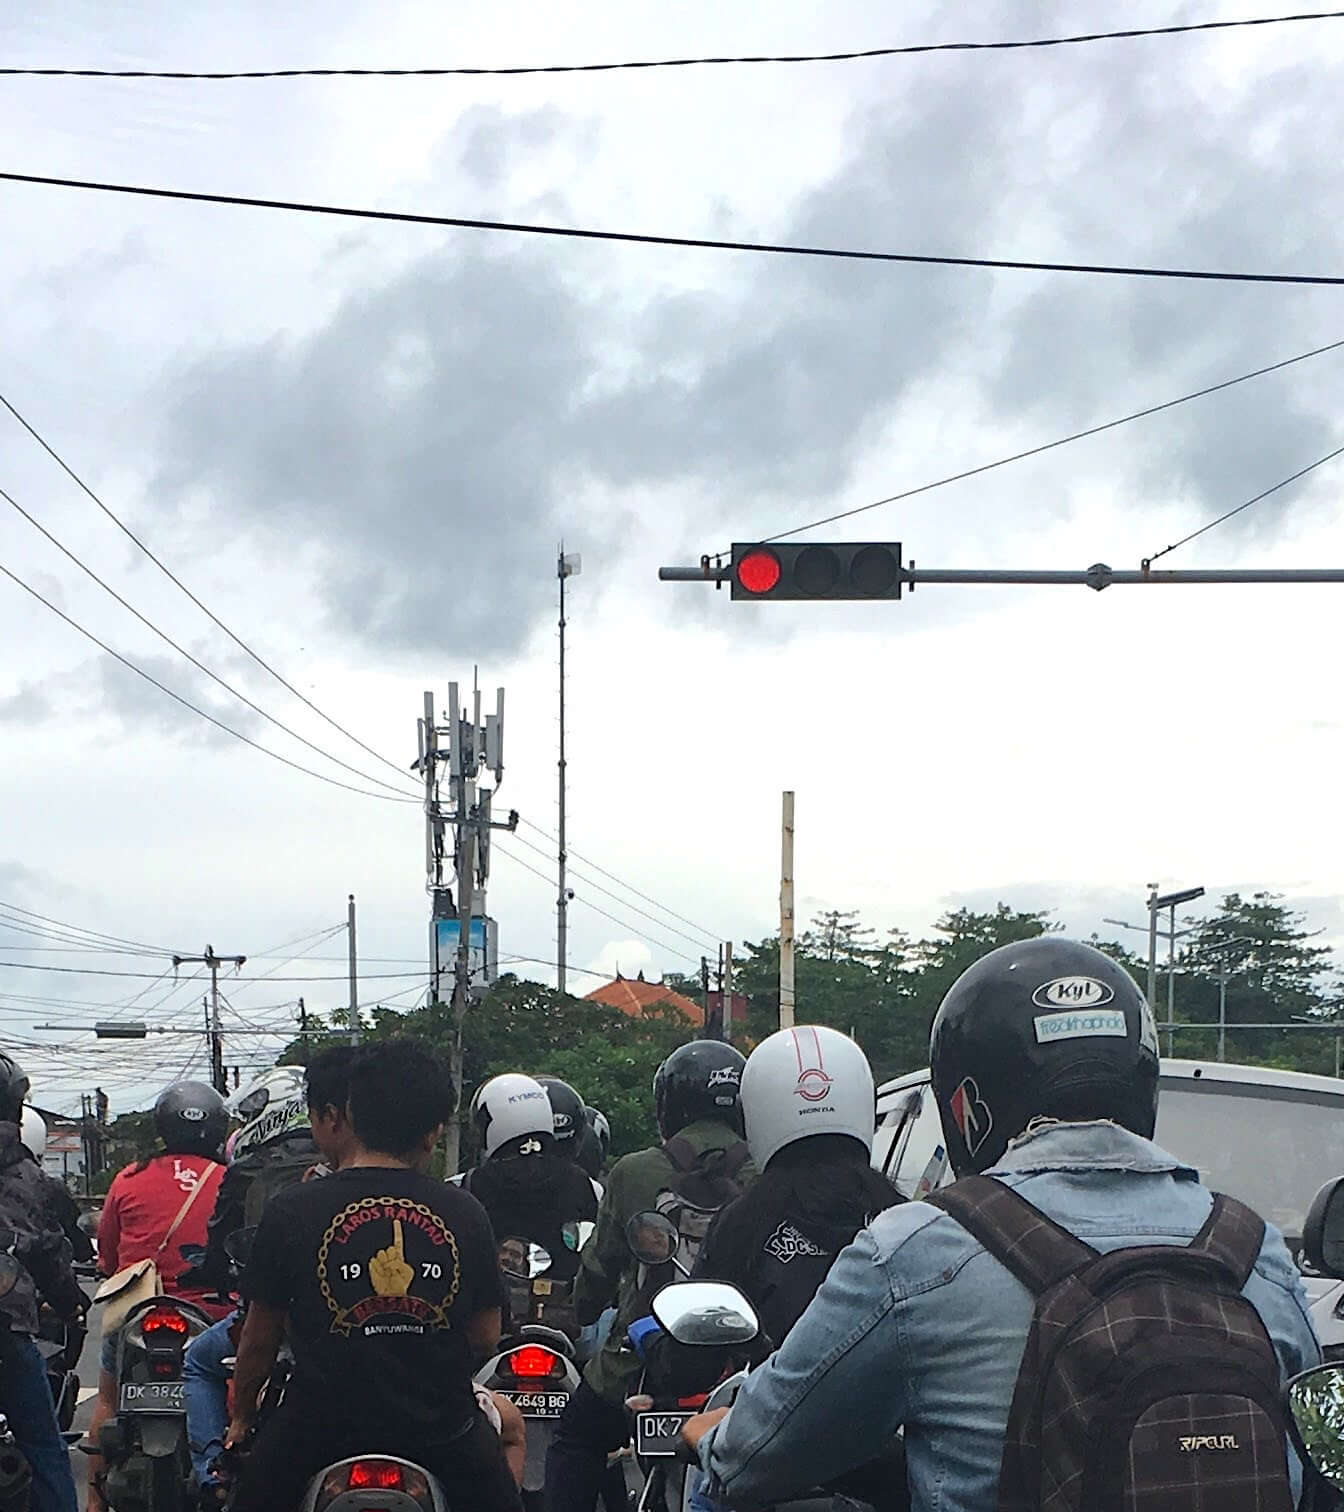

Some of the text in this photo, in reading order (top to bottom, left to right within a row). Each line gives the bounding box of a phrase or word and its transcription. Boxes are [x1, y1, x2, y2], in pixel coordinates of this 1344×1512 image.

[508, 1092, 545, 1103] KYMCO
[798, 1107, 835, 1115] HONDA
[384, 1207, 446, 1245] RANTAU
[340, 1263, 361, 1280] 19
[421, 1263, 442, 1279] 70
[127, 1386, 144, 1399] DK
[514, 1394, 546, 1407] 4649
[548, 1396, 566, 1408] BG
[645, 1417, 682, 1437] DK 7
[1179, 1435, 1240, 1451] RIPCURL
